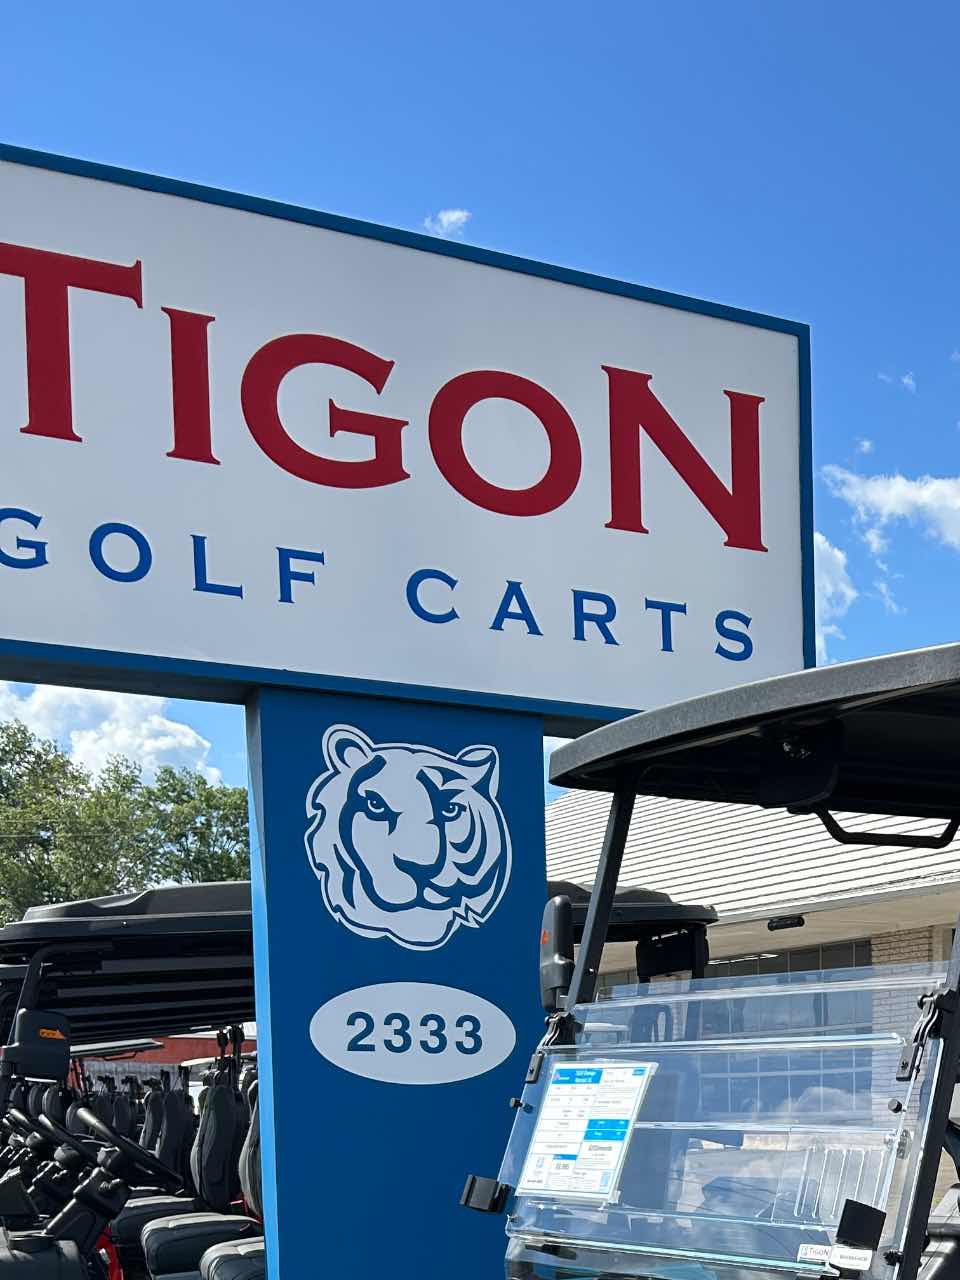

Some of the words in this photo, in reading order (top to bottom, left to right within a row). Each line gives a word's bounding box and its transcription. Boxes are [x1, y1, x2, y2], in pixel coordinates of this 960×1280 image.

[0, 243, 767, 552] TIGON
[0, 508, 324, 603] GOLF
[406, 570, 752, 661] CARTS
[346, 1011, 483, 1055] 2333
